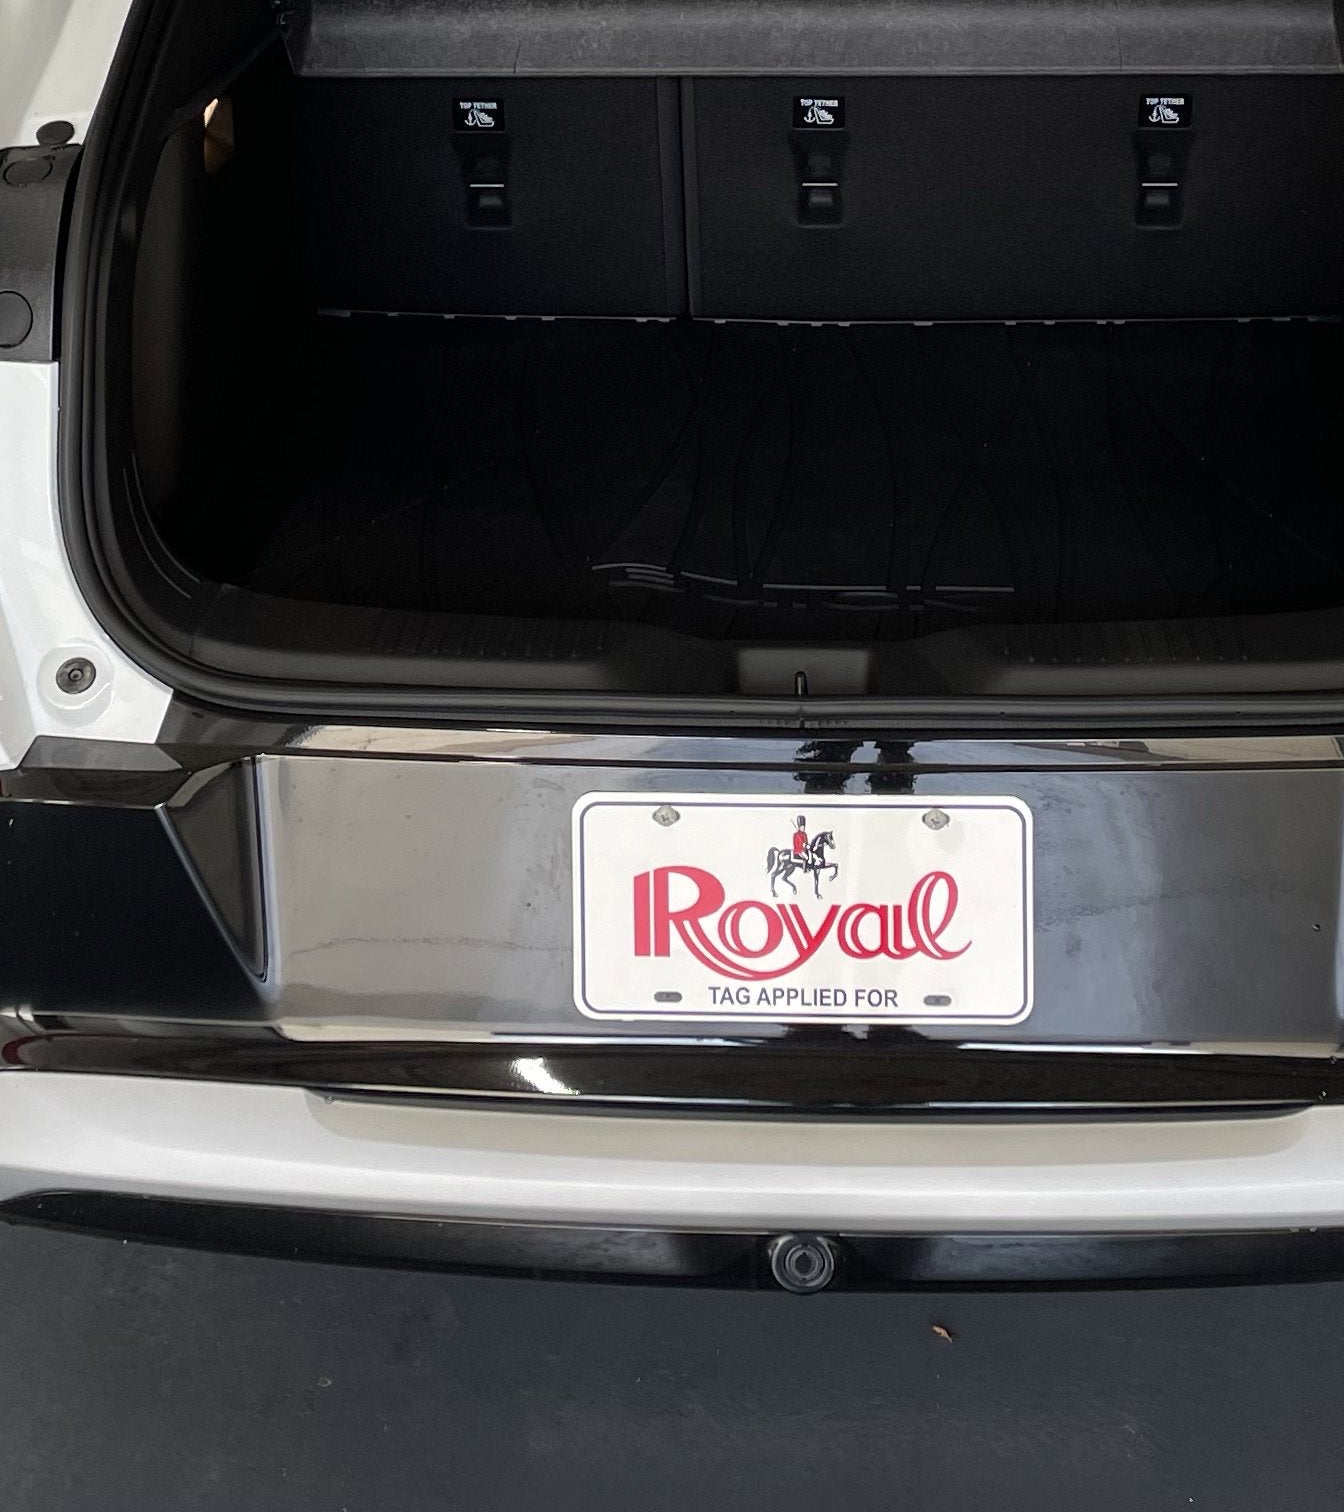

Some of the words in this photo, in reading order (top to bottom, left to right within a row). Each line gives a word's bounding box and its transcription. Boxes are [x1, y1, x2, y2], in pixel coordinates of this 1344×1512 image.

[633, 865, 973, 981] Royal
[708, 986, 751, 1007] TAG
[757, 987, 847, 1008] APPLIED
[855, 988, 899, 1009] FOR
